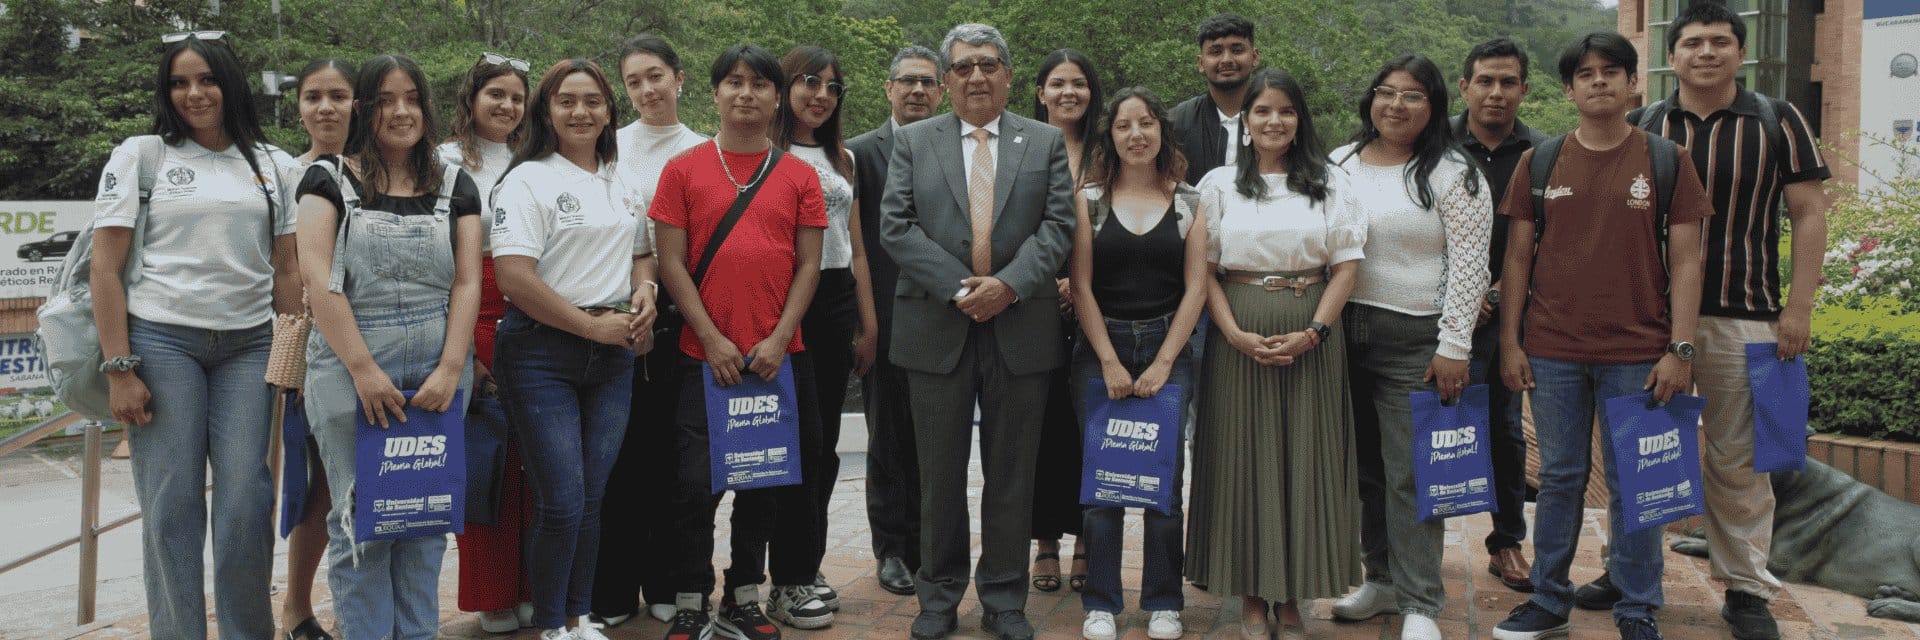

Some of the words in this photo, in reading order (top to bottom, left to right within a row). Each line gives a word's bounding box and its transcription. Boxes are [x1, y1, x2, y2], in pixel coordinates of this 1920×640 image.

[1627, 199, 1650, 207] LONDON
[0, 211, 57, 234] RDE
[30, 267, 44, 275] en
[728, 394, 779, 416] UDES
[752, 410, 780, 427] Global!
[1106, 418, 1160, 441] UDES
[384, 434, 447, 457] UDES
[1128, 440, 1159, 452] Global!
[1431, 426, 1476, 449] UDES
[1638, 428, 1680, 456] UDES
[412, 452, 447, 471] Global!
